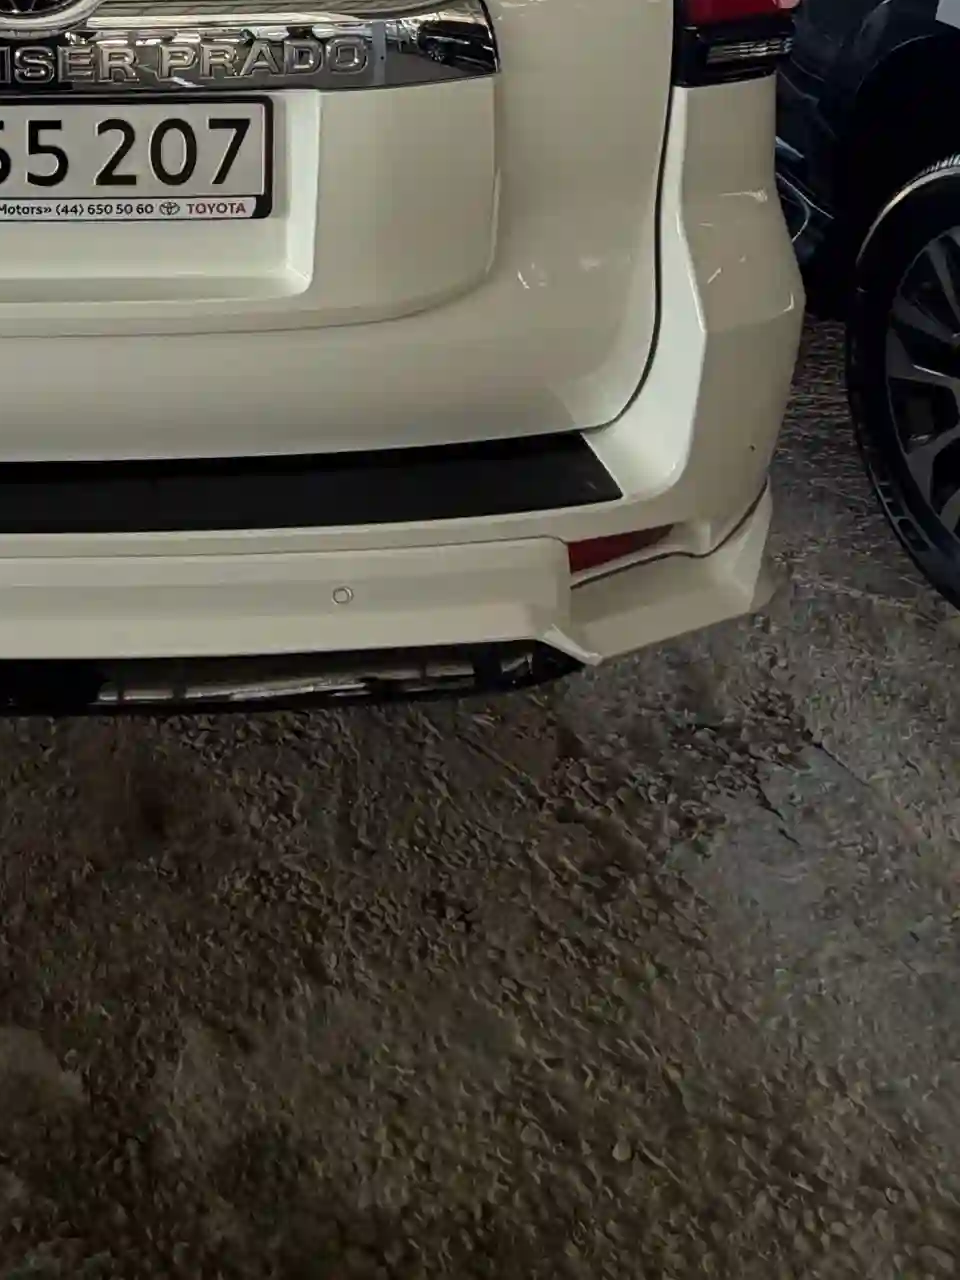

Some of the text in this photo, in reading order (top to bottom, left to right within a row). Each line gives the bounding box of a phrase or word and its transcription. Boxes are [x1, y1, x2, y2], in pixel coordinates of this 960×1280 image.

[156, 35, 369, 80] PRADO
[93, 117, 251, 187] 207
[55, 203, 85, 216] (44)
[87, 203, 113, 216] 650
[115, 203, 134, 215] 50
[135, 202, 154, 215] 60
[187, 201, 247, 214] TOYOTA
